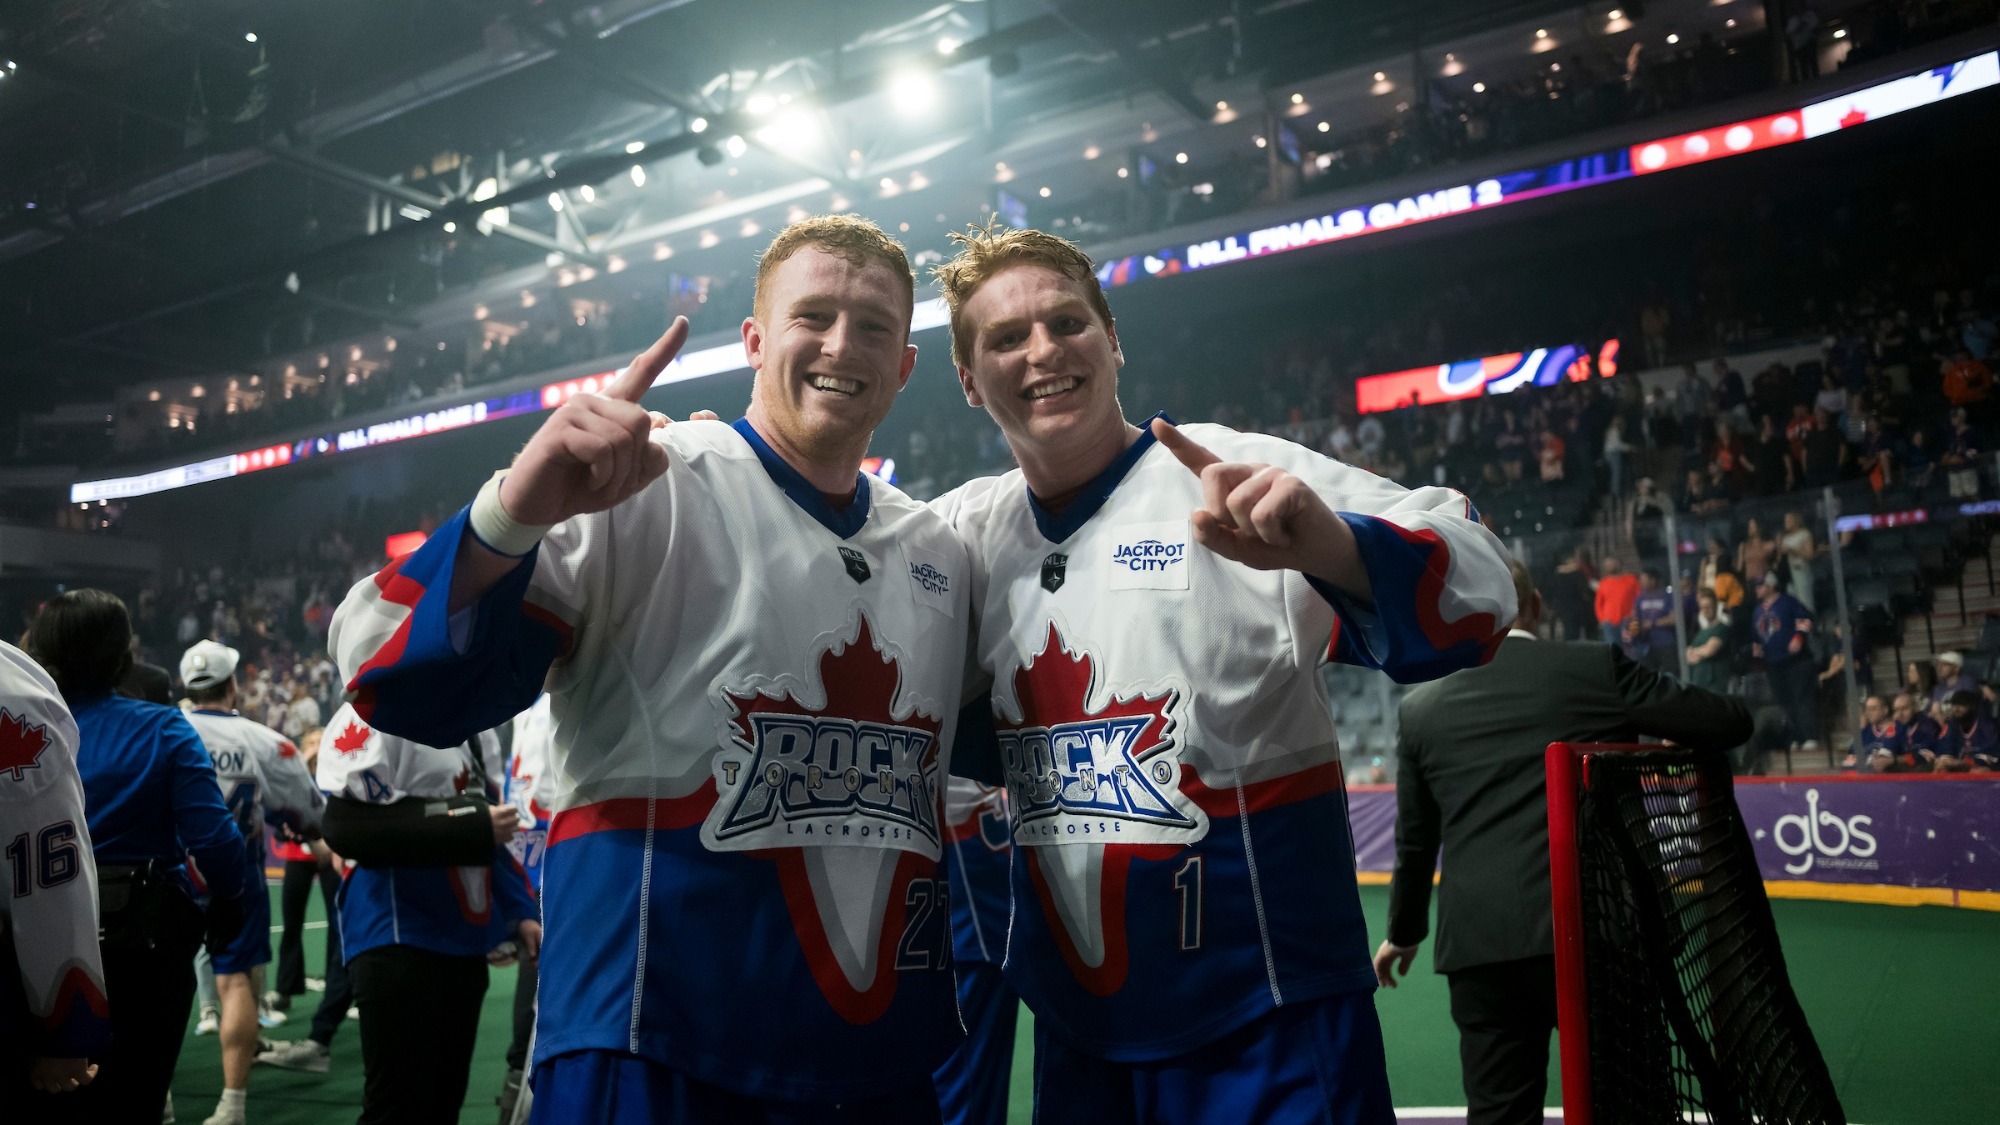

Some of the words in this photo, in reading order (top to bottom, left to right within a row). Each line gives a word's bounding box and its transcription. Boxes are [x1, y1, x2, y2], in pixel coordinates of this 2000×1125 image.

[1188, 236, 1247, 268] NLL
[1250, 210, 1366, 255] FINALS
[1369, 185, 1472, 228] GAME
[1476, 180, 1503, 206] 2
[840, 549, 863, 561] NLL
[1044, 554, 1069, 567] NLL
[1113, 543, 1185, 558] JACKPOT
[910, 562, 948, 586] JACKPOT
[1129, 558, 1168, 571] CITY
[922, 578, 942, 596] CITY
[730, 717, 936, 830] ROCK
[787, 823, 912, 840] LACROSSE
[1022, 821, 1121, 836] LACROSSE
[1774, 788, 1877, 875] gbs
[6, 820, 79, 899] 16
[1174, 855, 1202, 951] 1
[894, 878, 949, 971] 27
